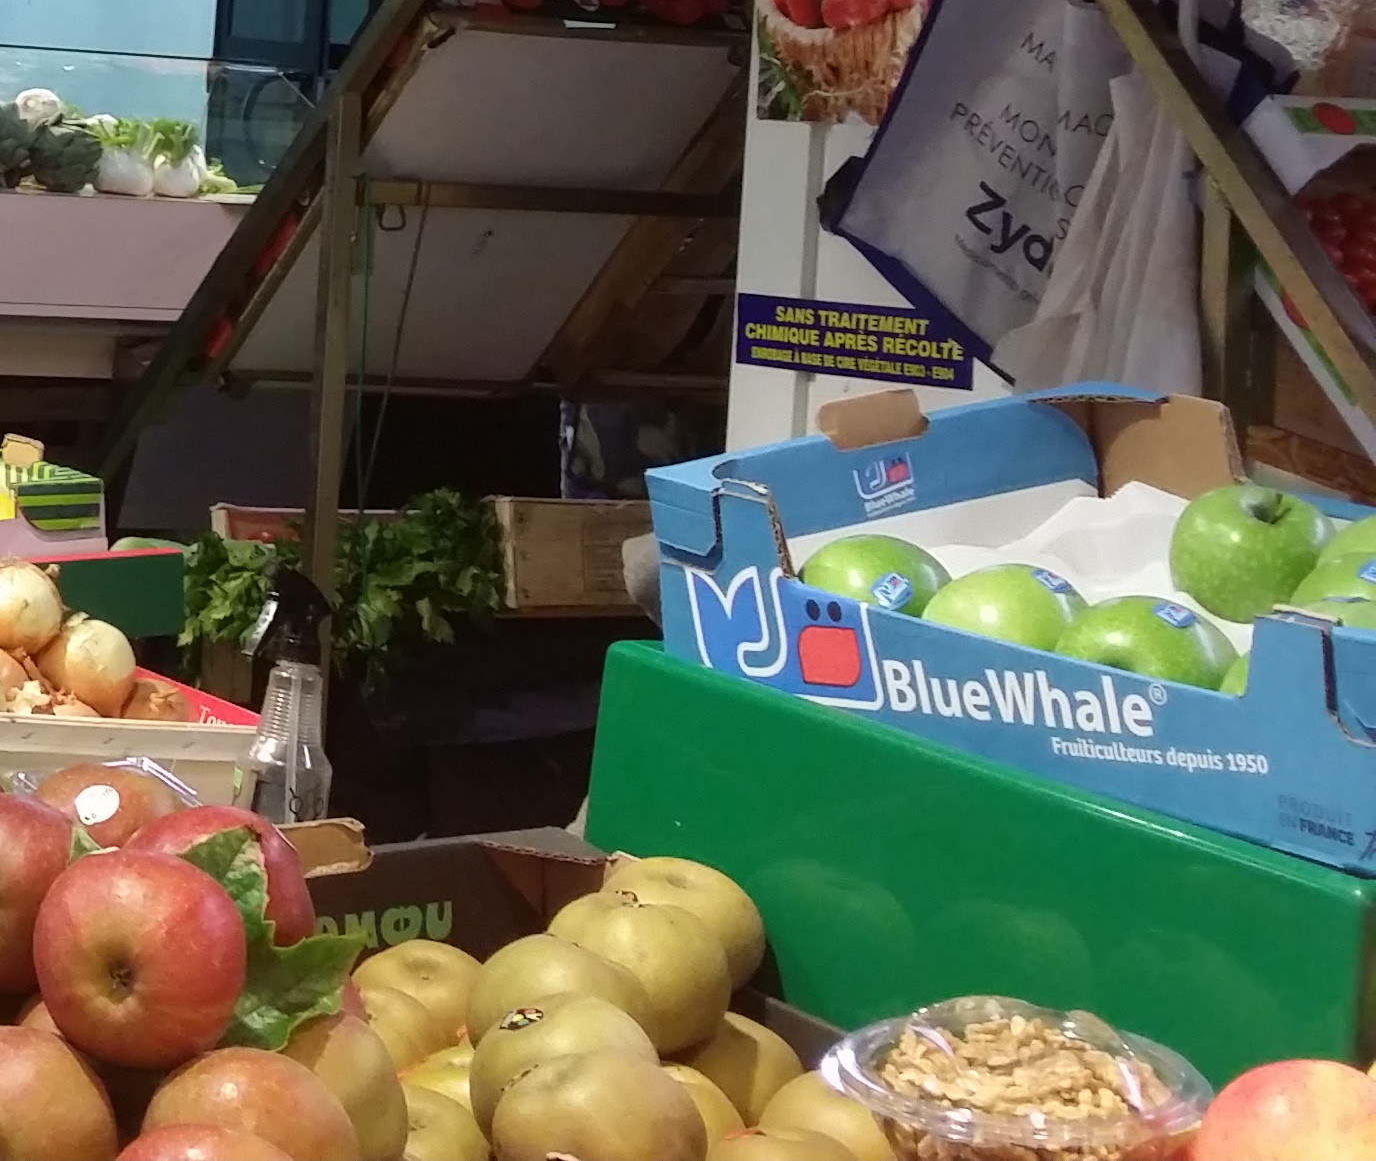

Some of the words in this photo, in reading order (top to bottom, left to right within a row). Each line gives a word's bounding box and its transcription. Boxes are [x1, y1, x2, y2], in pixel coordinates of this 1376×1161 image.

[775, 305, 815, 325] SANS
[818, 310, 930, 336] TRAITEMENT
[744, 322, 820, 347] CHIMIQUE
[823, 330, 879, 352] APRÈS
[882, 336, 965, 361] RÉCOLTE
[1051, 736, 1163, 767] Fruiticulteurs
[1165, 746, 1223, 774] depuis
[1226, 750, 1270, 775] 1950
[1298, 817, 1355, 847] FRANCE
